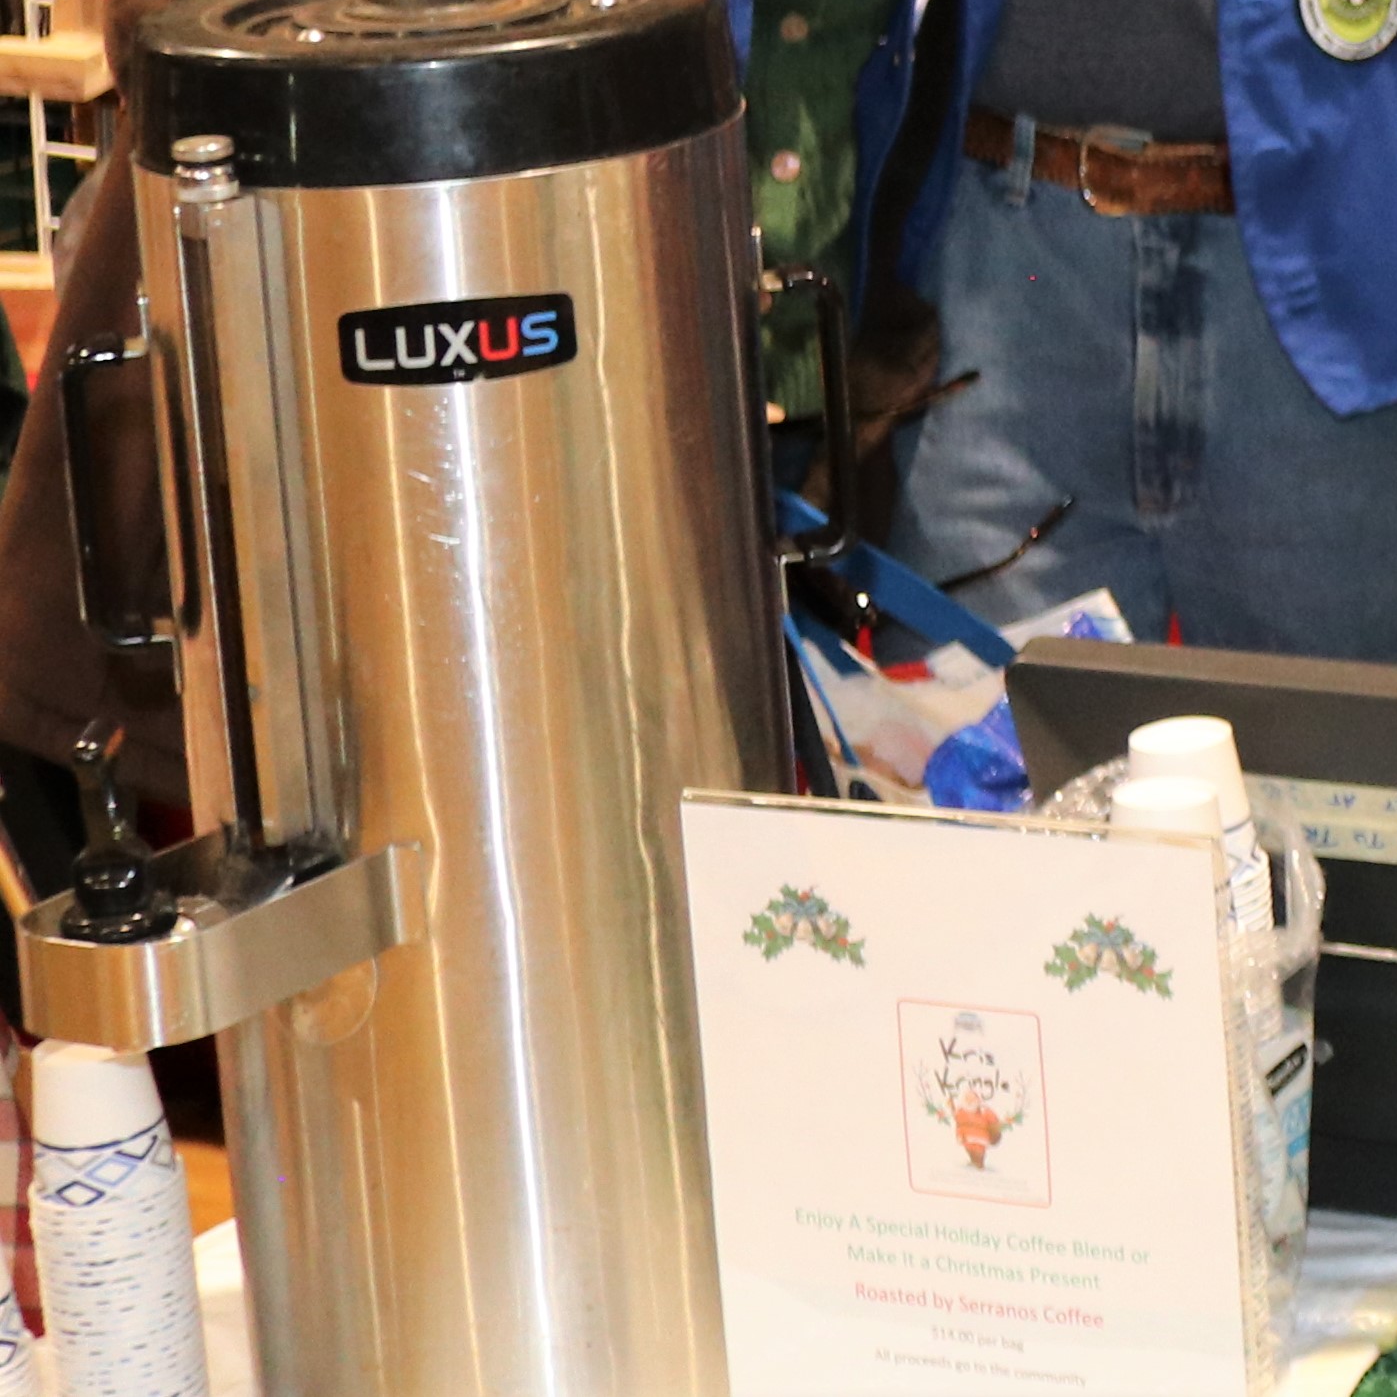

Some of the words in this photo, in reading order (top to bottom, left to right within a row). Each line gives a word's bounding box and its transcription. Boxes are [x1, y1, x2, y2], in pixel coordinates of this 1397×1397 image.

[354, 310, 559, 371] LUXUS
[938, 1037, 995, 1066] Kris
[934, 1066, 1009, 1101] Kringle
[795, 1207, 843, 1232] Enjoy
[849, 1215, 862, 1230] A
[866, 1216, 929, 1239] Special
[935, 1224, 1001, 1251] Holiday
[1006, 1233, 1067, 1257] Coffee
[1072, 1240, 1125, 1262] Blend
[1131, 1250, 1152, 1265] or
[847, 1244, 897, 1266] Make
[920, 1259, 931, 1271] a
[936, 1256, 1025, 1284] Christmas
[1030, 1268, 1102, 1290] Present
[855, 1282, 927, 1307] Roasted
[932, 1291, 954, 1313] by
[959, 1295, 1038, 1322] Serranos
[1043, 1305, 1104, 1329] Coffee
[977, 1333, 997, 1349] per
[1001, 1334, 1024, 1353] bag
[875, 1347, 891, 1362] All
[894, 1352, 951, 1370] proceeds
[955, 1359, 971, 1374] go
[974, 1361, 987, 1374] to
[990, 1362, 1011, 1378] the
[1014, 1367, 1087, 1389] community
